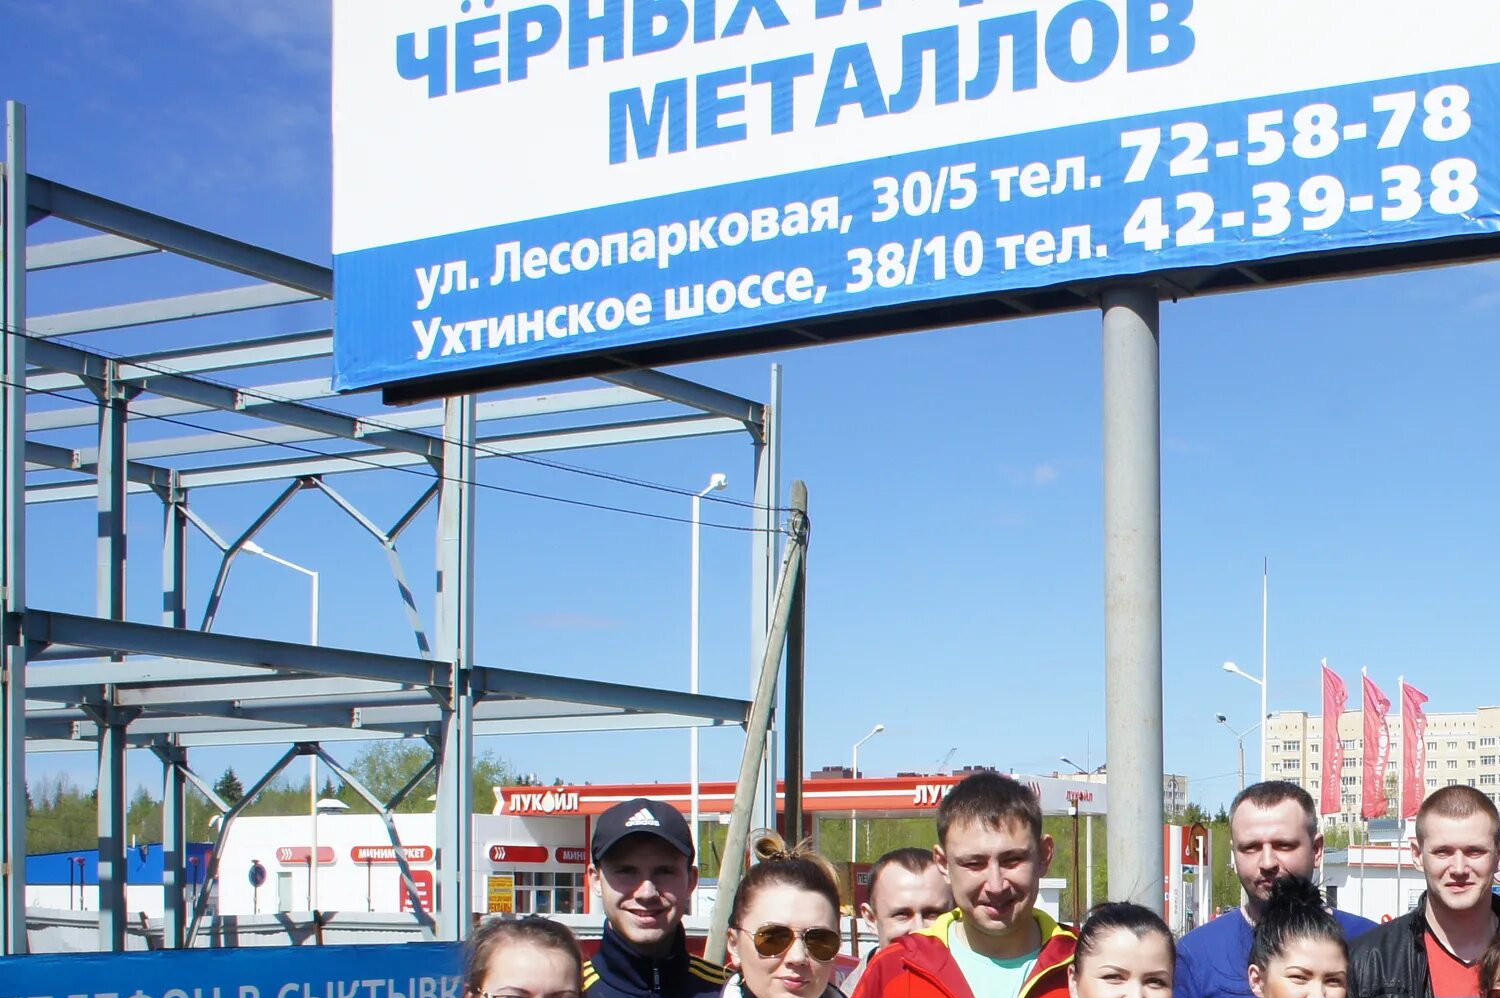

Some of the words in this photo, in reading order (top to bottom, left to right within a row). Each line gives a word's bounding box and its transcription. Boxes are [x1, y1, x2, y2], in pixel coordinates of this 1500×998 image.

[608, 0, 1196, 165] МЕТАЛЛОВ
[411, 292, 653, 361] Ухтинское
[664, 266, 828, 321] шоссе,
[845, 229, 984, 294] 38/10
[995, 224, 1109, 271] тел.
[1123, 156, 1480, 251] 42-39-38
[415, 260, 479, 309] ул.
[489, 195, 853, 286] Лесопарковая,
[872, 161, 978, 222] 30/5
[990, 155, 1102, 202] тел.
[1120, 83, 1472, 183] 72-58-78
[358, 848, 426, 859] МИНИМРКЕТ
[509, 788, 579, 813] ЛУКОЙЛ
